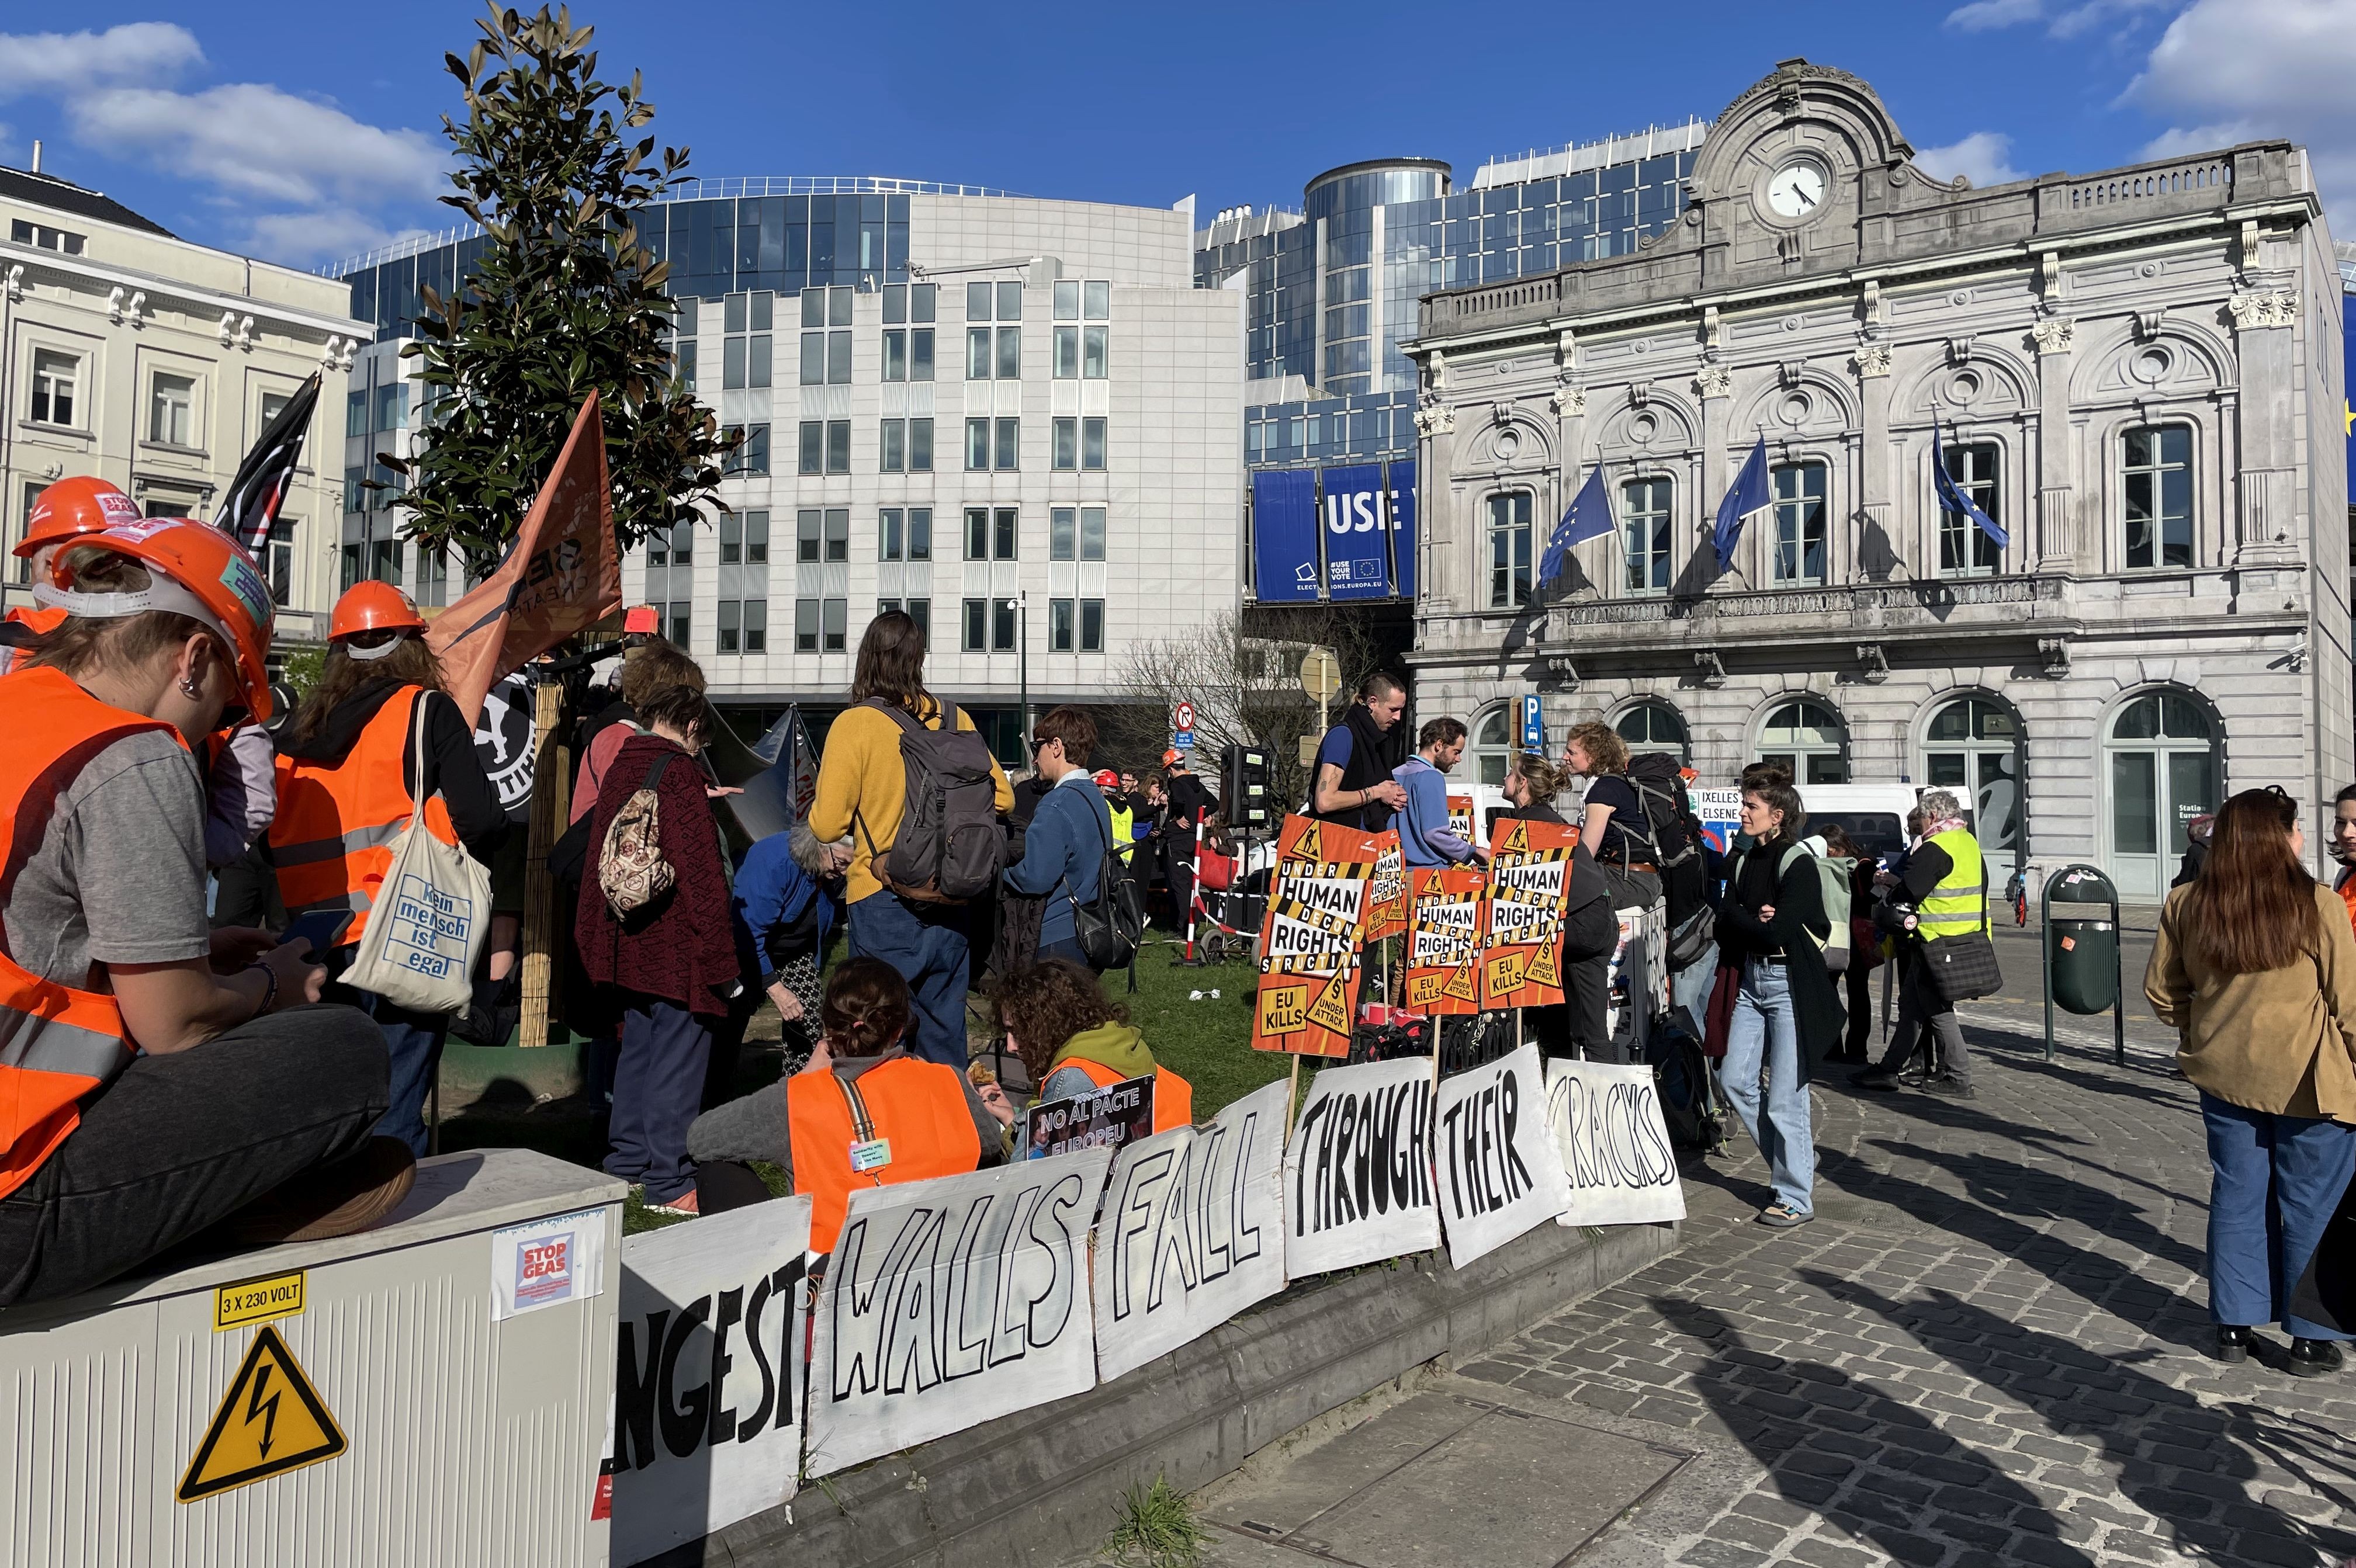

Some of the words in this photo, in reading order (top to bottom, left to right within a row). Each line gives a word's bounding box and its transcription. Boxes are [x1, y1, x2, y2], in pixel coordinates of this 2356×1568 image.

[1327, 490, 1402, 534] USE
[1527, 698, 1538, 724] P
[1702, 792, 1738, 803] IXELLES
[1703, 808, 1738, 819] ELSENE
[1281, 863, 1336, 877] UNDER
[1495, 852, 1541, 868] UNDER
[1371, 878, 1401, 896] IGHTS
[1498, 869, 1561, 890] HUMAN
[1283, 877, 1357, 914] HUMAN
[1417, 895, 1455, 907] UNDER
[1515, 890, 1565, 907] DECON-
[400, 901, 466, 937] mensch
[1301, 908, 1361, 936] DECON-
[1370, 917, 1385, 932] KILLS
[1373, 913, 1380, 921] EU
[1420, 908, 1473, 925] HUMAN
[1495, 907, 1555, 927] RIGHTS
[411, 924, 438, 949] ist
[1275, 924, 1350, 955] RIGHTS
[1435, 925, 1478, 939] DECON-
[1487, 920, 1564, 948] STRUCTION
[1418, 937, 1471, 953] RIGHTS
[409, 952, 450, 976] egal
[1262, 954, 1360, 972] STRUCTION
[1409, 948, 1480, 969] STRUCTION
[1499, 958, 1513, 974] EU
[1533, 959, 1554, 973] UNDER
[1420, 977, 1434, 990] EU
[1451, 979, 1471, 990] UNDER
[1492, 971, 1522, 992] KILLS
[1530, 968, 1554, 981] ATTACK
[1276, 991, 1294, 1009] EU
[1414, 987, 1441, 1002] KILLS
[1449, 986, 1470, 997] ATTACK
[1319, 998, 1345, 1017] UNDER
[1266, 1009, 1302, 1029] KILLS
[1314, 1008, 1344, 1028] ATTACK
[1041, 1109, 1066, 1134] NO
[1068, 1102, 1090, 1126] AL
[1092, 1087, 1139, 1118] PACTE
[1052, 1122, 1125, 1156] EUROPEU
[1296, 1078, 1432, 1237] THROUGH
[1113, 1112, 1261, 1323] FALL
[524, 1243, 566, 1264] STOP
[523, 1257, 566, 1279] GEAS
[223, 1299, 231, 1313] 3
[234, 1295, 242, 1311] X
[245, 1291, 267, 1309] 230
[271, 1283, 299, 1303] VOLT
[832, 1174, 1083, 1403] WALLS
[614, 1251, 806, 1475] NGEST
